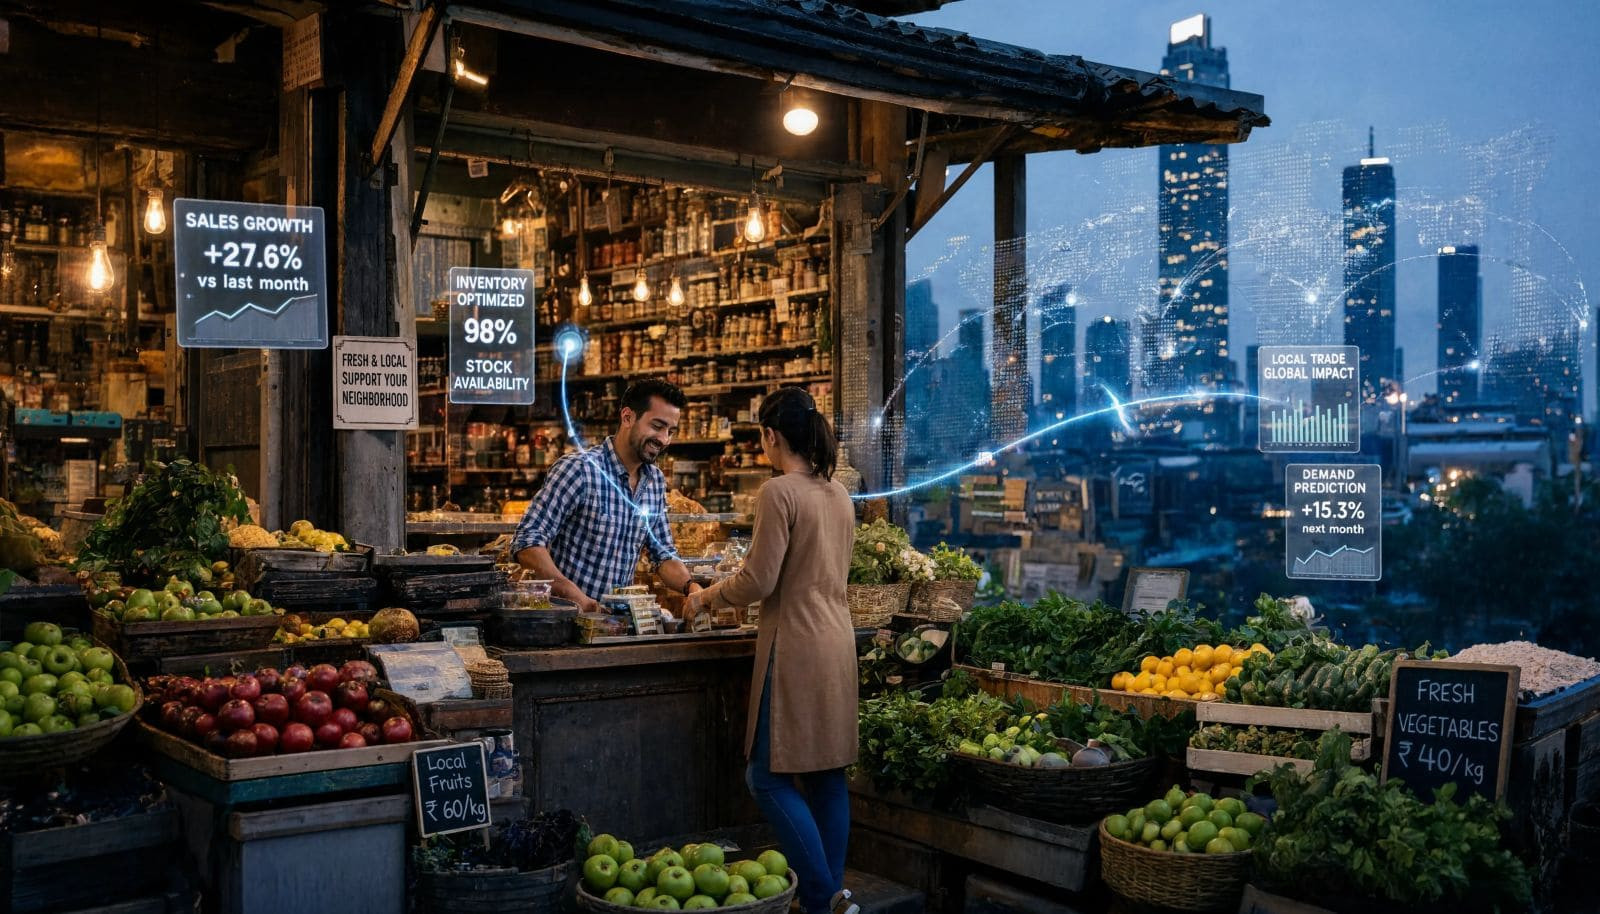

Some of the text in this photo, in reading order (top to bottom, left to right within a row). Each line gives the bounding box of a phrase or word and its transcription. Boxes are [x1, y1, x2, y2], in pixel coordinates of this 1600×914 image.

[342, 353, 408, 368] FRESH & LOCAL
[342, 372, 408, 387] SUPPORT YOUR
[342, 390, 408, 407] NEIGHBORHOOD
[1418, 679, 1474, 704] FRESH
[1398, 713, 1499, 742] VEGETABLES
[427, 752, 467, 771] Local
[1418, 743, 1484, 785] 40/kg
[429, 773, 473, 794] Fruits
[443, 794, 486, 823] 60/kg
